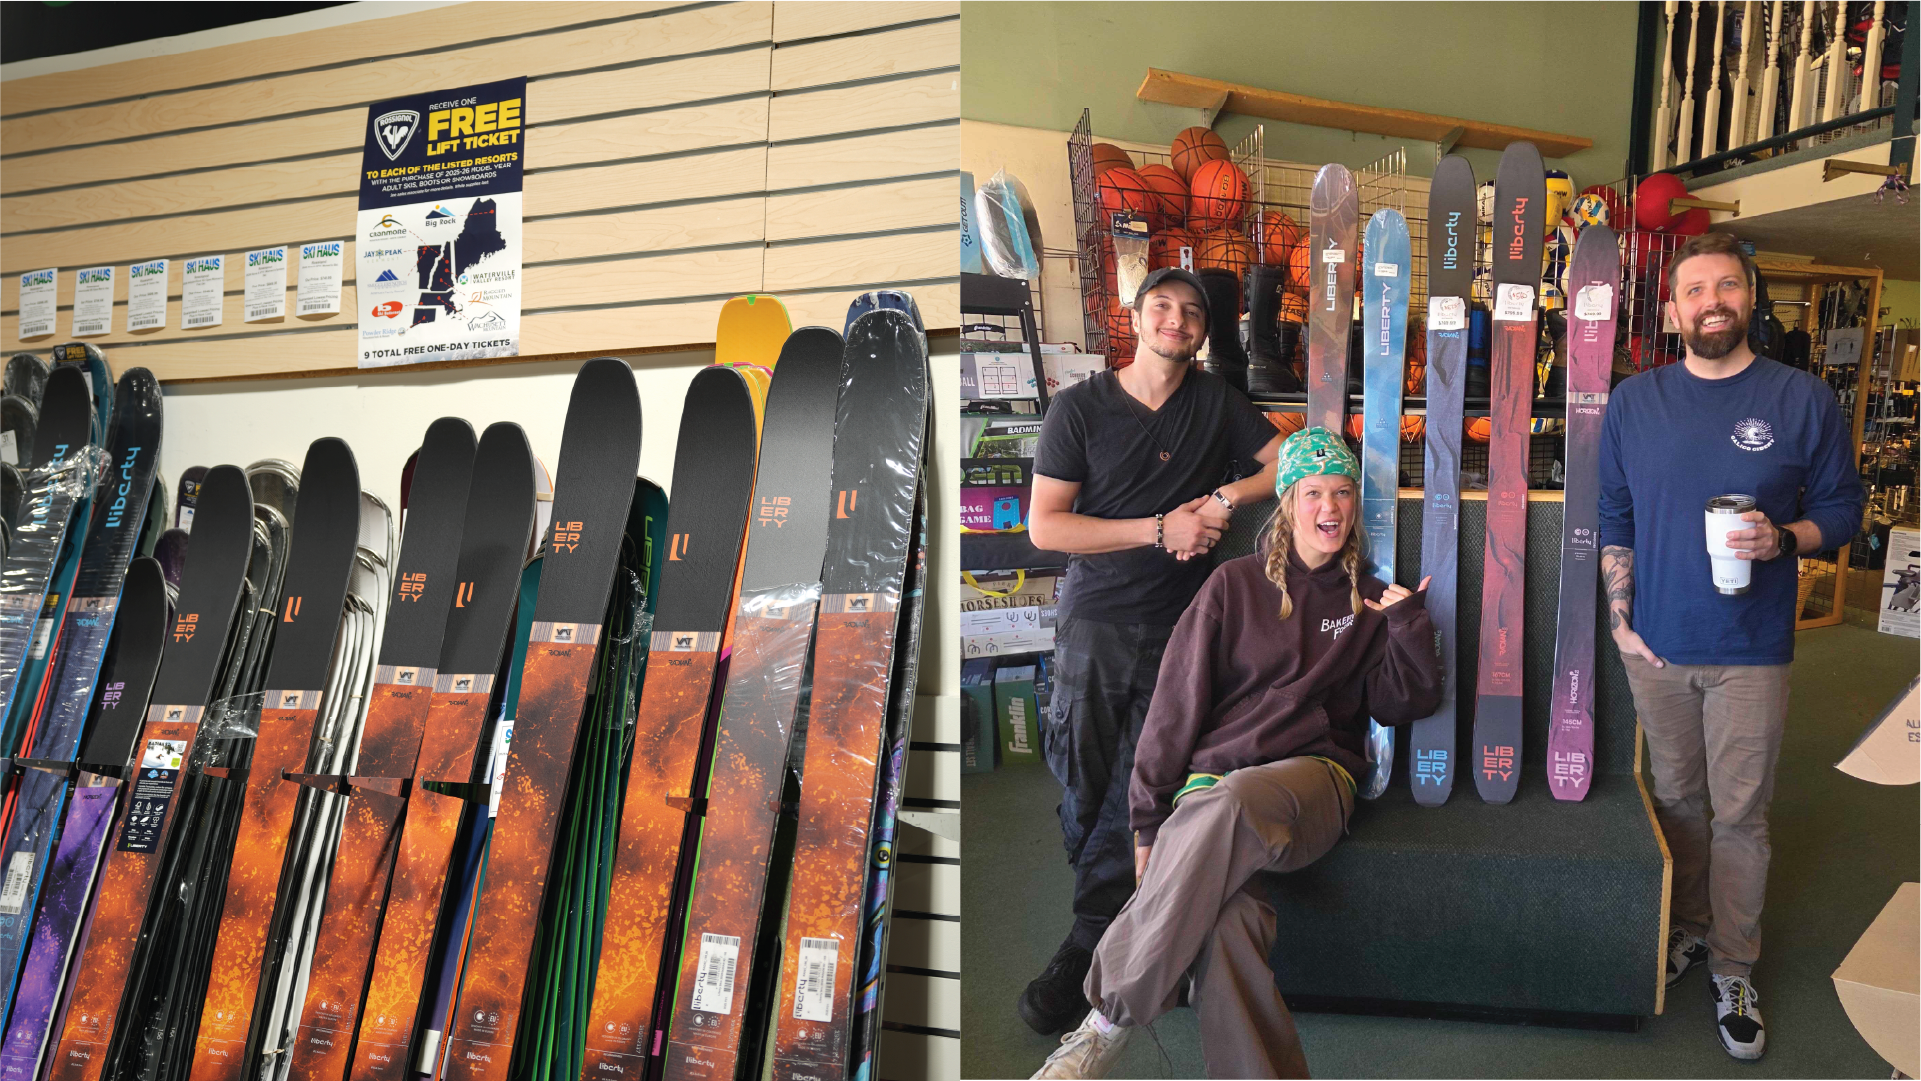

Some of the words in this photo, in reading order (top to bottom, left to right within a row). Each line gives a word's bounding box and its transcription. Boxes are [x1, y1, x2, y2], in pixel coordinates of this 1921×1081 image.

[429, 99, 460, 111] RECEIVE
[460, 97, 477, 107] ONE
[428, 98, 521, 141] FREE
[427, 137, 460, 156] LIFT
[461, 129, 521, 151] TICKET
[366, 170, 379, 180] TO
[380, 167, 406, 179] EACH
[407, 165, 421, 176] OF
[423, 163, 441, 173] THE
[441, 159, 473, 170] LISTED
[474, 152, 518, 167] RESORTS
[371, 177, 388, 186] WITH
[388, 175, 400, 184] THE
[401, 171, 435, 182] PURCHASE
[435, 171, 445, 180] OF
[445, 167, 471, 177] 2025-26
[471, 164, 493, 174] MODEL
[493, 162, 512, 171] YEAR
[382, 182, 402, 192] ADULT
[419, 178, 440, 188] BOOTS
[441, 176, 451, 185] OR
[452, 171, 497, 183] SNOWBOARDS
[425, 220, 437, 228] Big
[440, 217, 456, 226] Rock
[1509, 197, 1528, 260] liberty
[1443, 212, 1461, 270] liberty
[249, 253, 261, 266] SKI
[261, 249, 284, 265] HAUS
[303, 246, 316, 260] SKI
[316, 243, 340, 258] HAUS
[131, 265, 144, 278] SKI
[144, 261, 164, 275] HAUS
[186, 262, 197, 275] SKI
[198, 258, 220, 273] HAUS
[22, 275, 33, 287] SKI
[32, 271, 53, 285] HAUS
[79, 271, 90, 284] SKI
[90, 268, 111, 282] HAUS
[1326, 237, 1339, 312] LIBERY
[1380, 282, 1392, 356] LIBERTY
[382, 328, 397, 336] Ridge
[364, 351, 370, 359] 9
[372, 347, 401, 358] TOTAL
[404, 345, 425, 355] FREE
[427, 341, 470, 353] ONE-DAY
[472, 338, 511, 349] TICKETS
[1731, 435, 1751, 451] CALICO
[761, 496, 792, 506] LIB
[759, 507, 789, 517] ER
[555, 521, 584, 532] LIB
[758, 518, 788, 528] TY
[553, 532, 581, 542] ER
[552, 543, 579, 554] TY
[402, 572, 427, 582] LIB
[400, 583, 425, 592] ER
[398, 593, 424, 602] TY
[850, 598, 869, 607] VAT
[177, 613, 199, 623] LIB
[175, 624, 196, 633] ER
[173, 634, 194, 643] TY
[1008, 697, 1033, 754] Franklin
[1417, 749, 1448, 760] LIB
[1483, 745, 1514, 756] LIB
[1483, 757, 1513, 769] ER
[1555, 752, 1586, 762] LIB
[1417, 762, 1446, 773] ER
[1554, 764, 1585, 775] ER
[1416, 774, 1446, 786] TY
[1482, 770, 1513, 782] TY
[1554, 776, 1585, 788] TY
[692, 972, 708, 1010] liberty
[795, 979, 808, 1017] liberty
[599, 1062, 624, 1074] liberty
[685, 1056, 715, 1068] liberty
